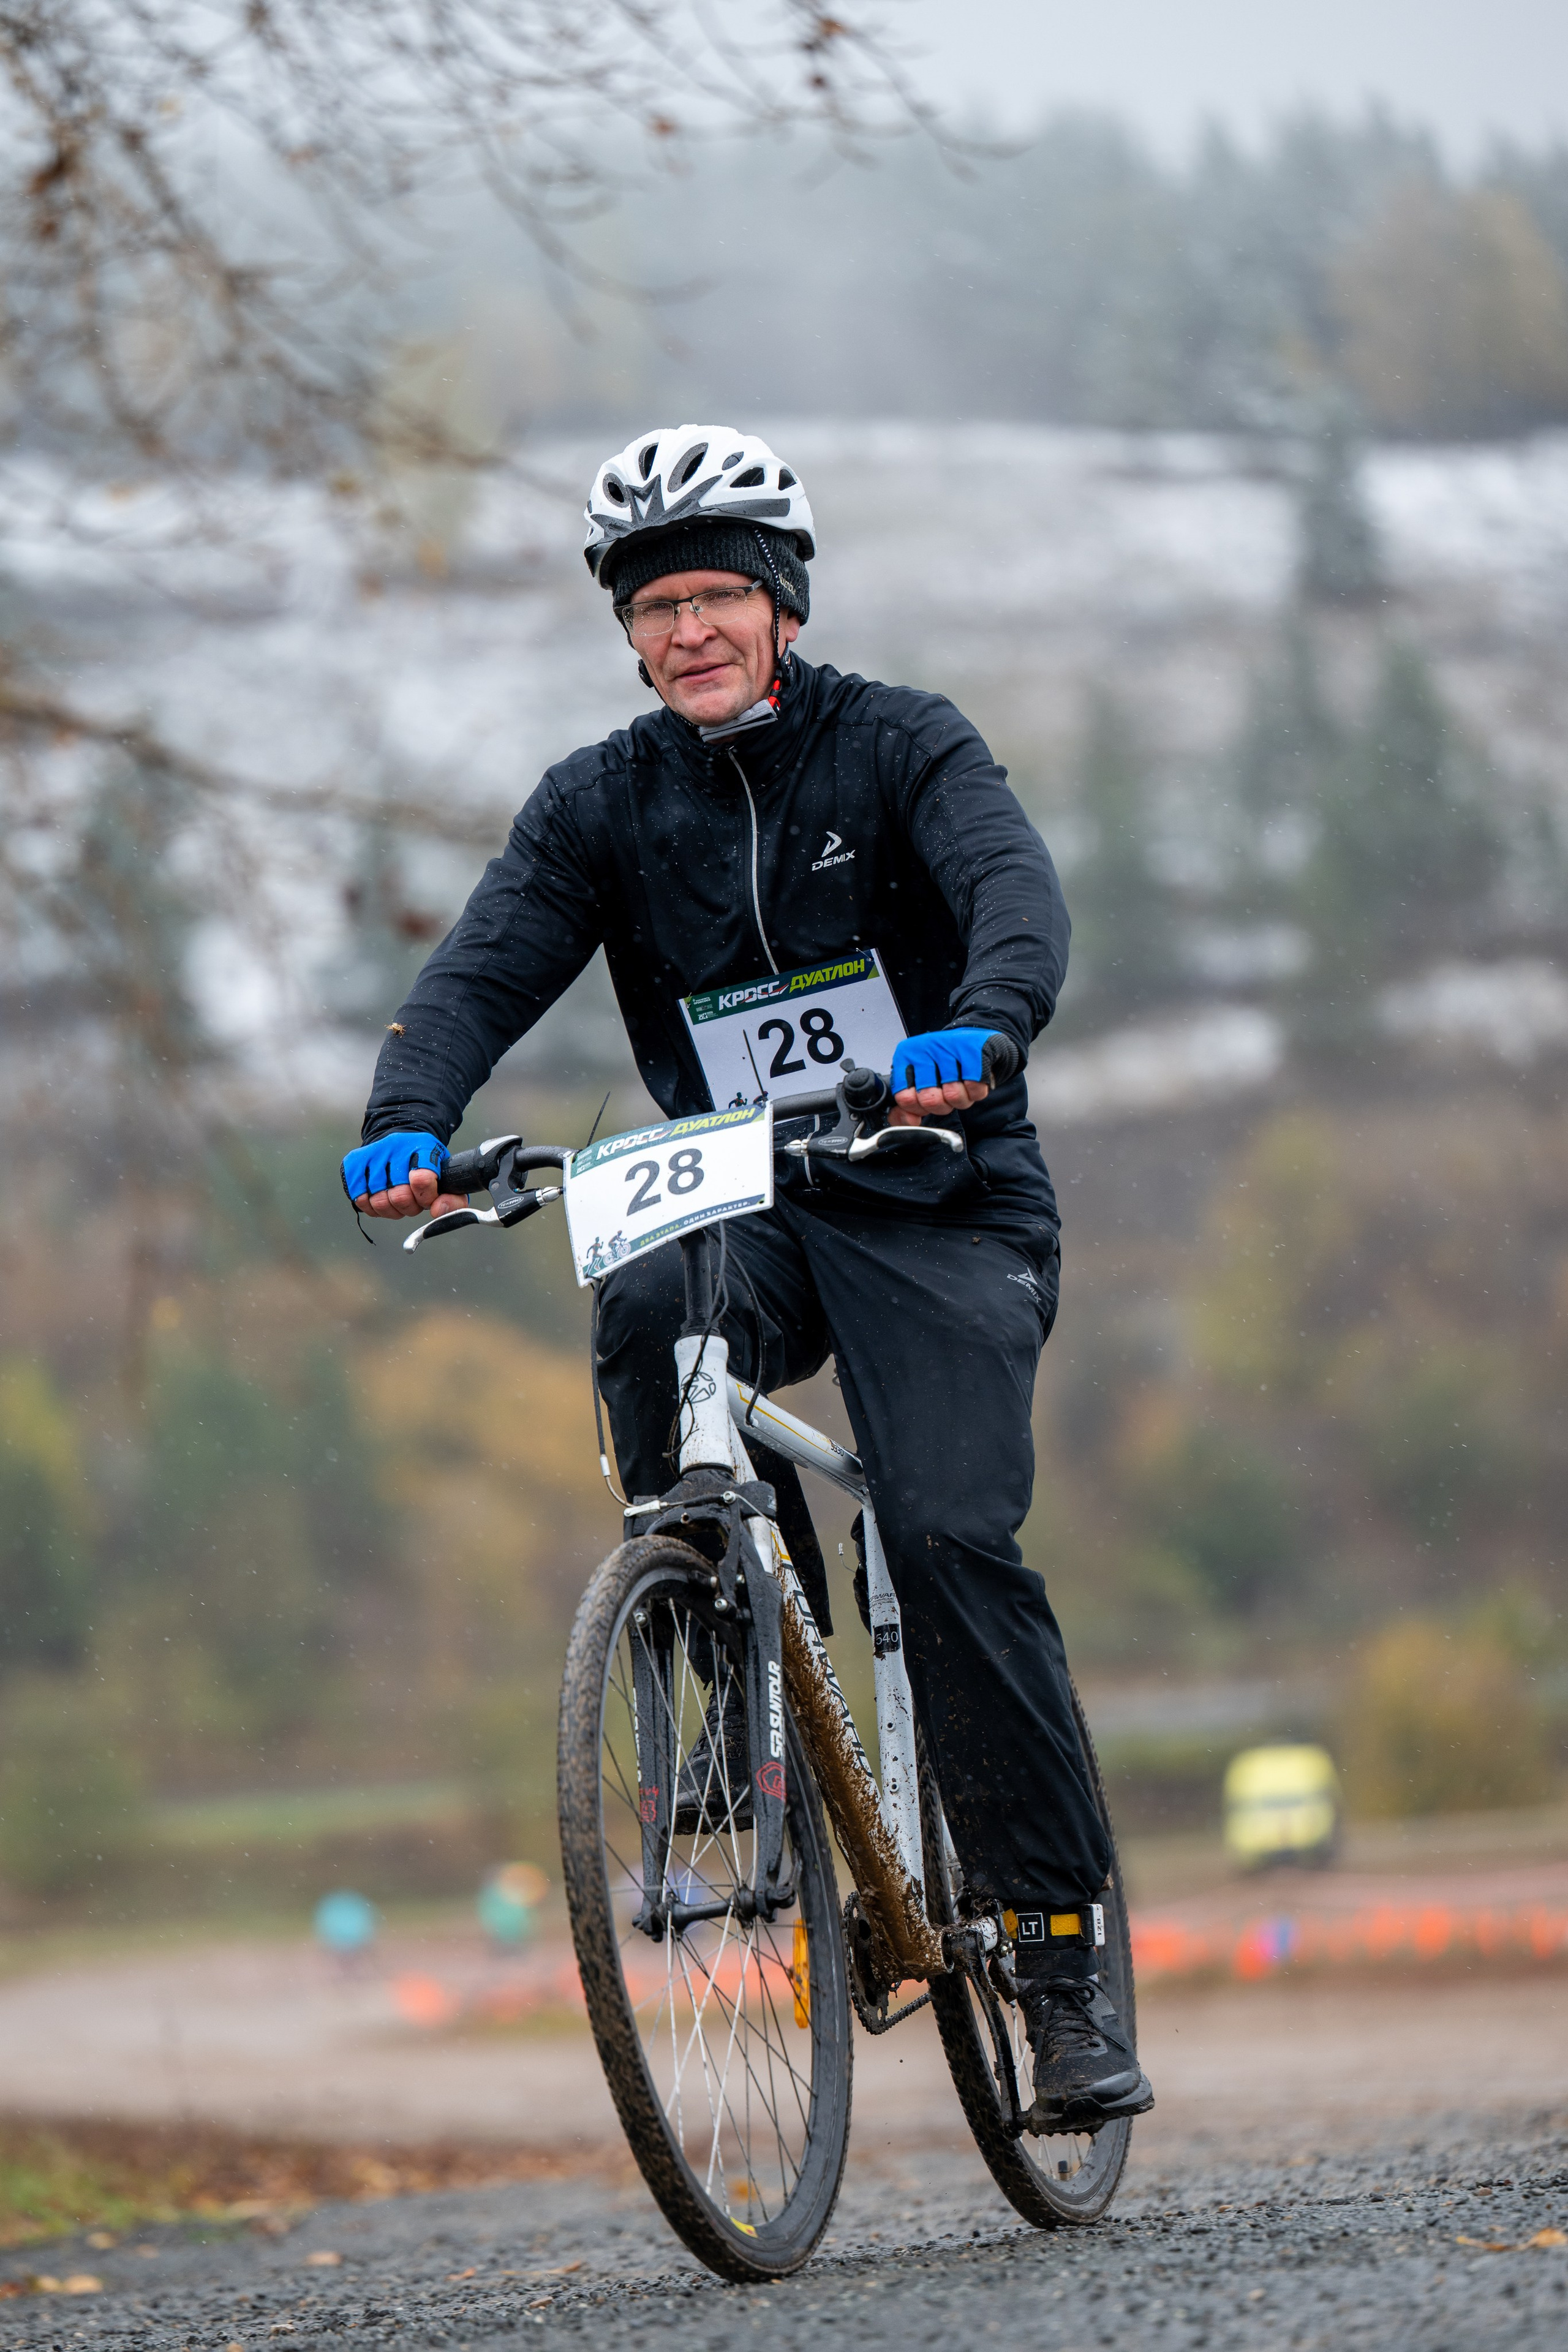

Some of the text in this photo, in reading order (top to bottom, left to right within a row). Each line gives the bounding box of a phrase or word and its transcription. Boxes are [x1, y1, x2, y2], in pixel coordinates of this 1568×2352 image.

[812, 850, 856, 871] DEMIX
[718, 959, 865, 1011] КРОСС ДУАТЛОН
[758, 1008, 845, 1079] 28
[596, 1107, 756, 1160] КРОСС ДУАТЛОН
[625, 1148, 704, 1217] 28
[500, 1198, 521, 1207] TEKTRO
[640, 1235, 655, 1246] ДВА
[684, 1213, 705, 1226] ОДИН
[1006, 1273, 1042, 1303] DEMIX
[876, 1631, 899, 1645] 540
[768, 1660, 783, 1730] SUNTOUR
[1022, 1921, 1038, 1935] LT
